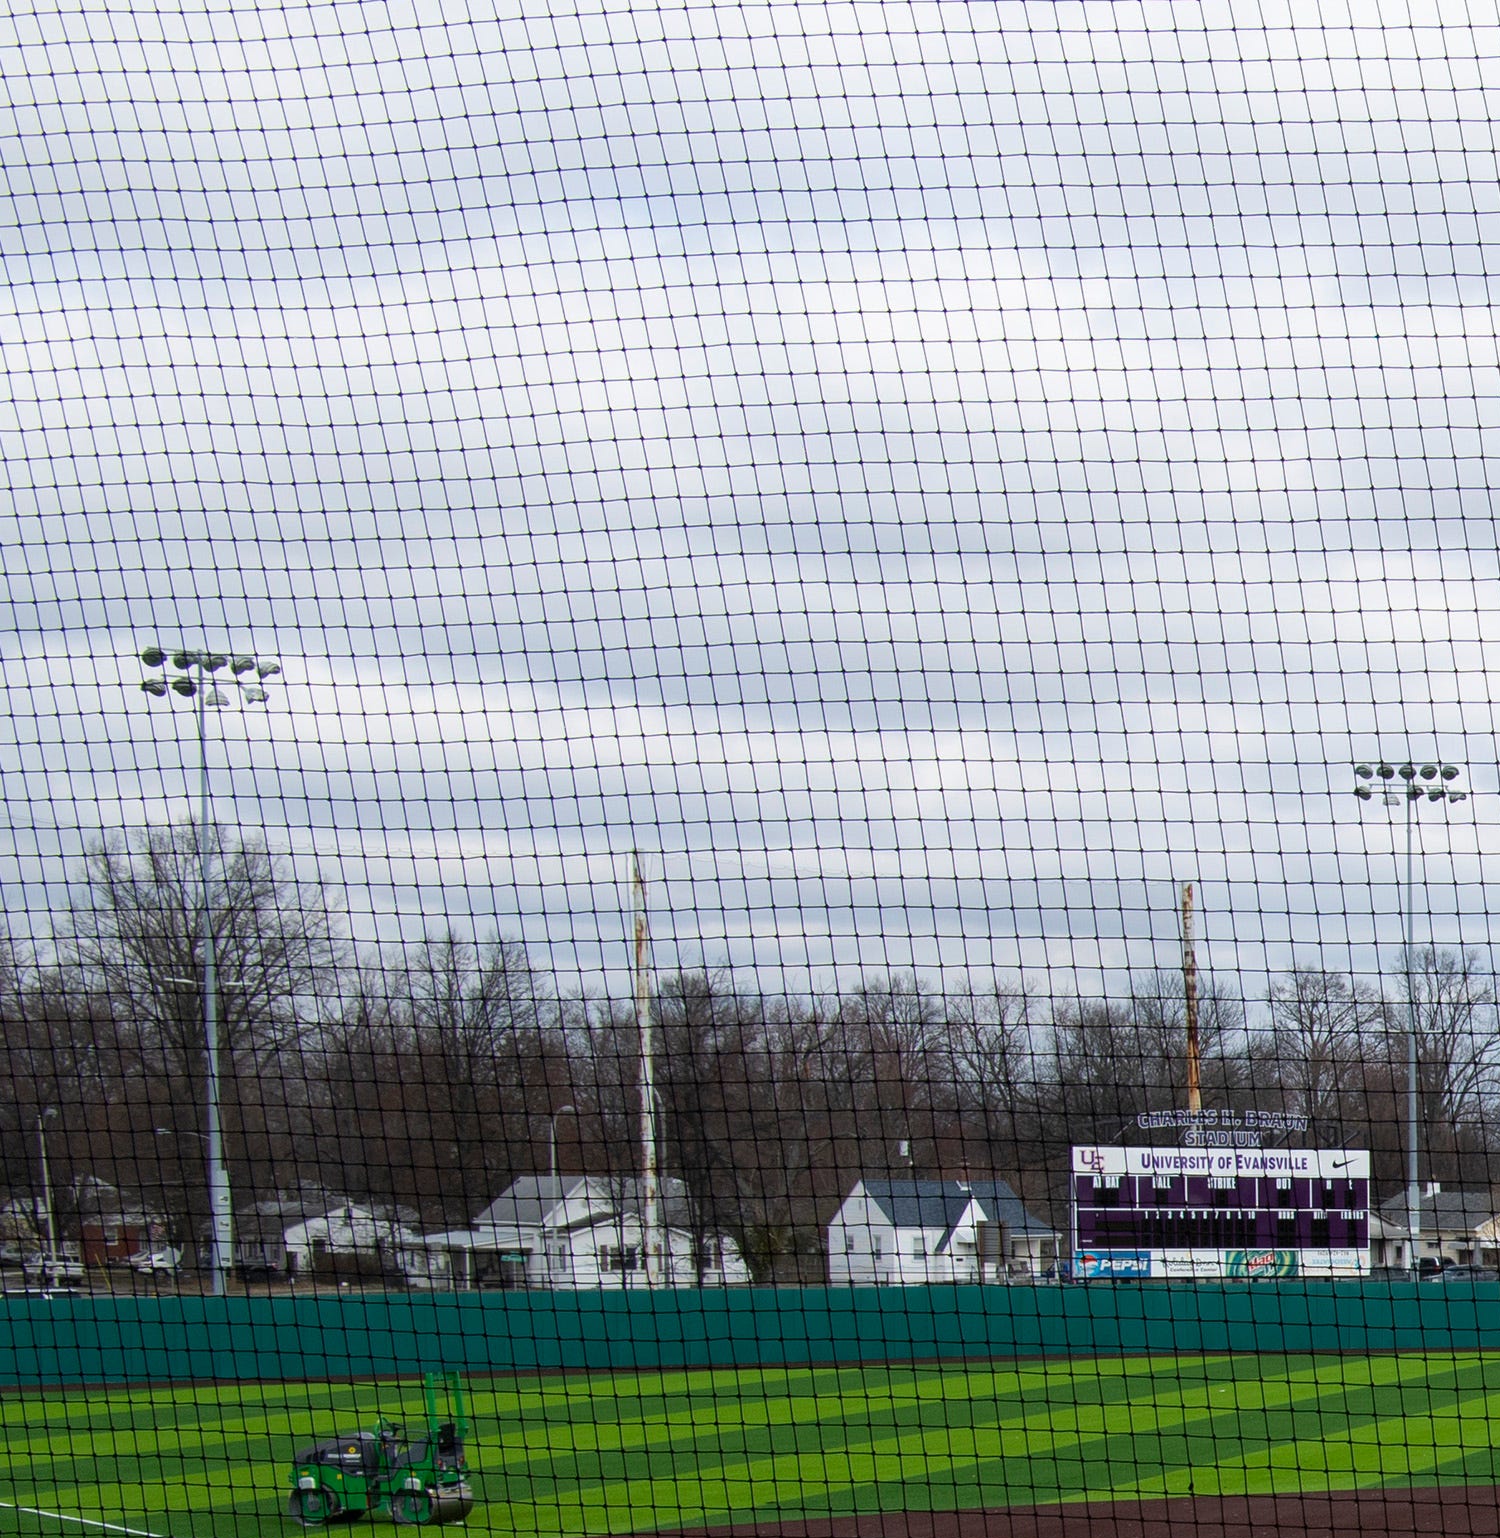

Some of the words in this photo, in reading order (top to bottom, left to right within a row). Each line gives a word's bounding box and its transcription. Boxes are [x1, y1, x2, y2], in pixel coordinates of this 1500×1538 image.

[1137, 1110, 1218, 1129] CHARLES
[1245, 1111, 1310, 1132] BRAUN
[1184, 1131, 1263, 1147] STADIUM
[1141, 1153, 1214, 1169] UNIVERSITY
[1218, 1157, 1232, 1169] OF
[1236, 1154, 1308, 1170] EVANSVILLE
[1100, 1258, 1149, 1271] PEPSI
